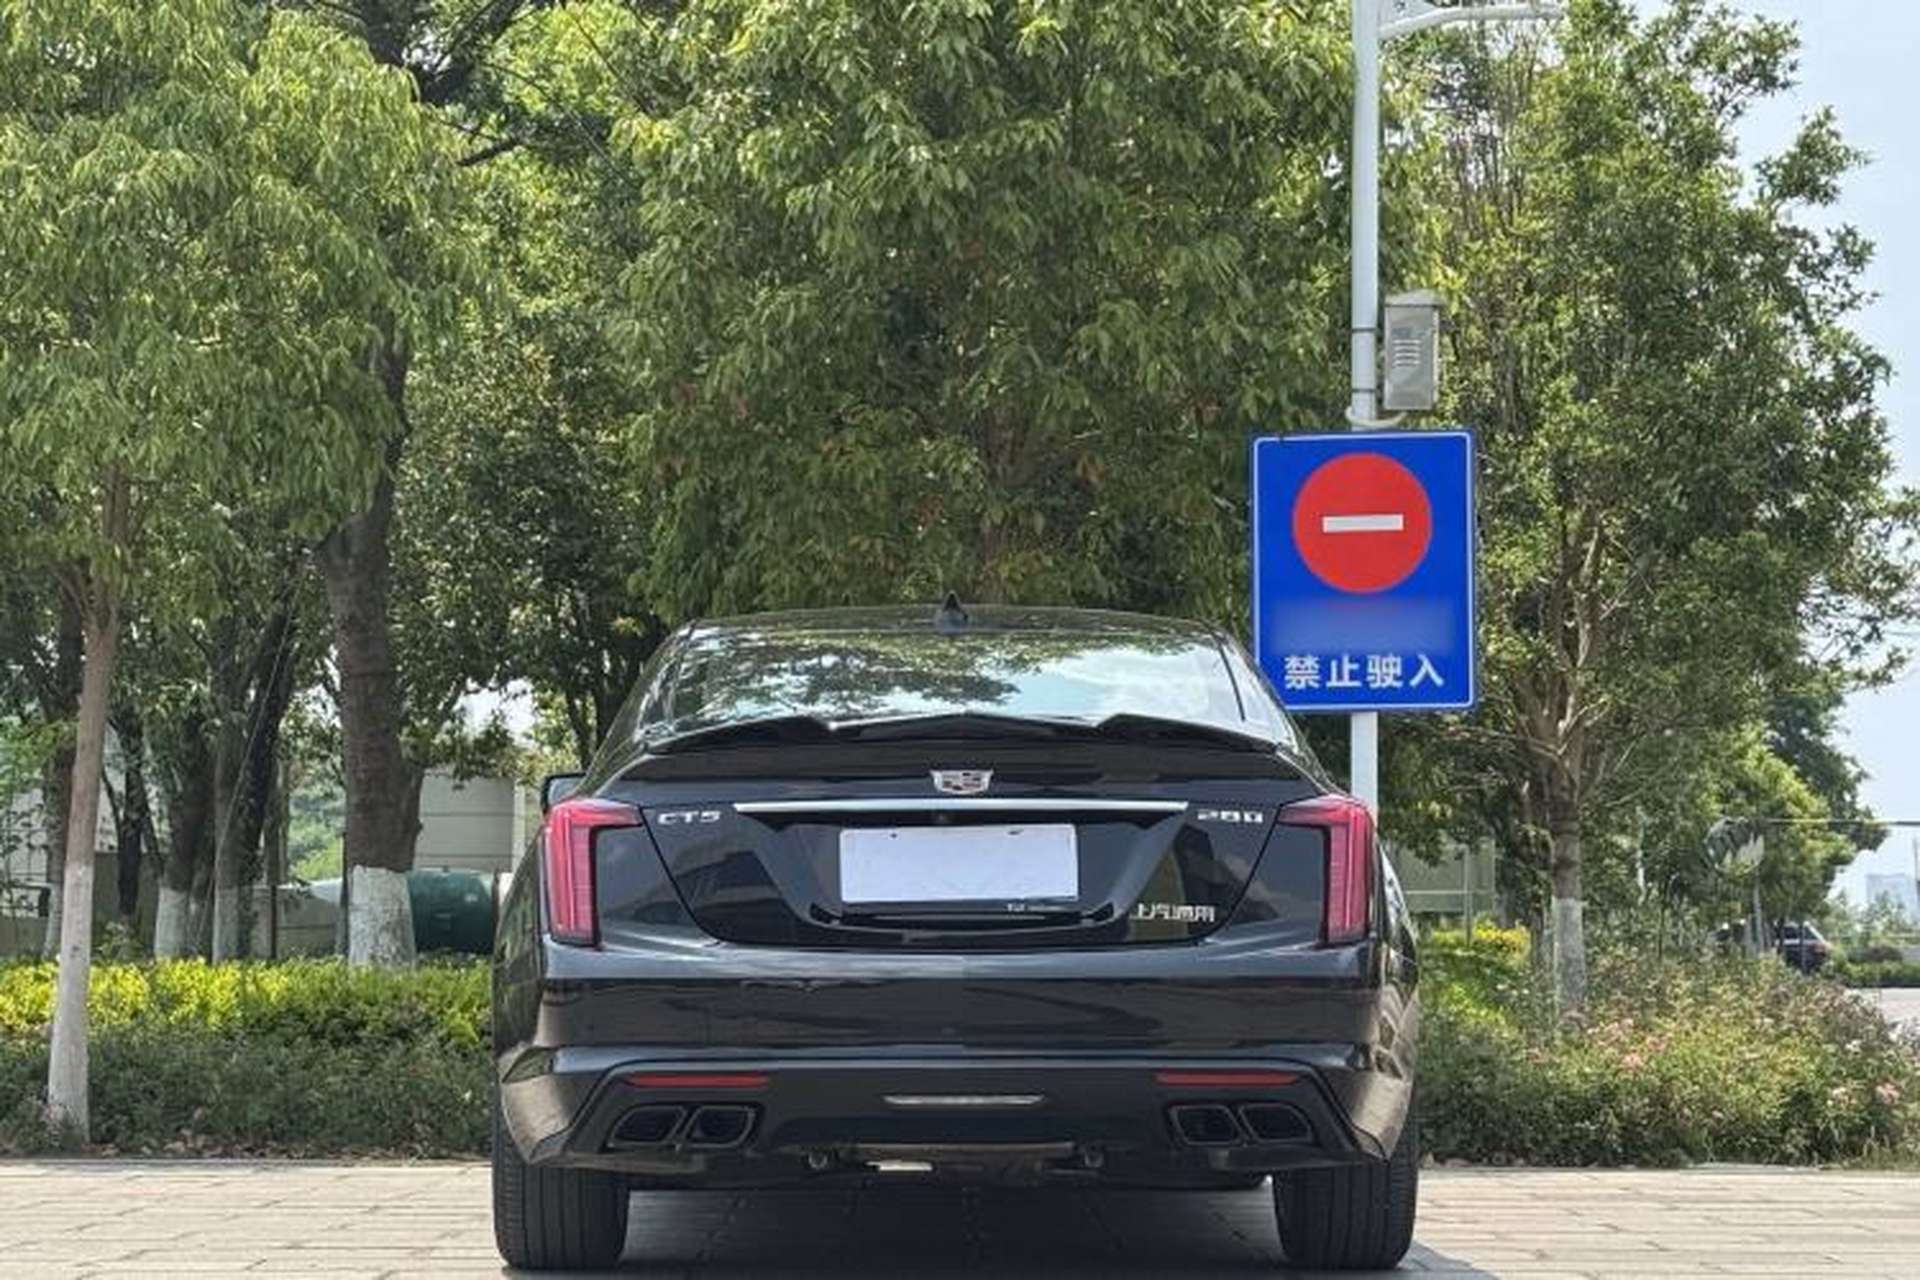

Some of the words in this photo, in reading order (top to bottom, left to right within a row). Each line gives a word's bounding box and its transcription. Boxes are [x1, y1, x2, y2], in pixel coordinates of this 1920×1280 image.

[1284, 653, 1445, 690] 禁止驶入
[657, 810, 721, 825] CT5
